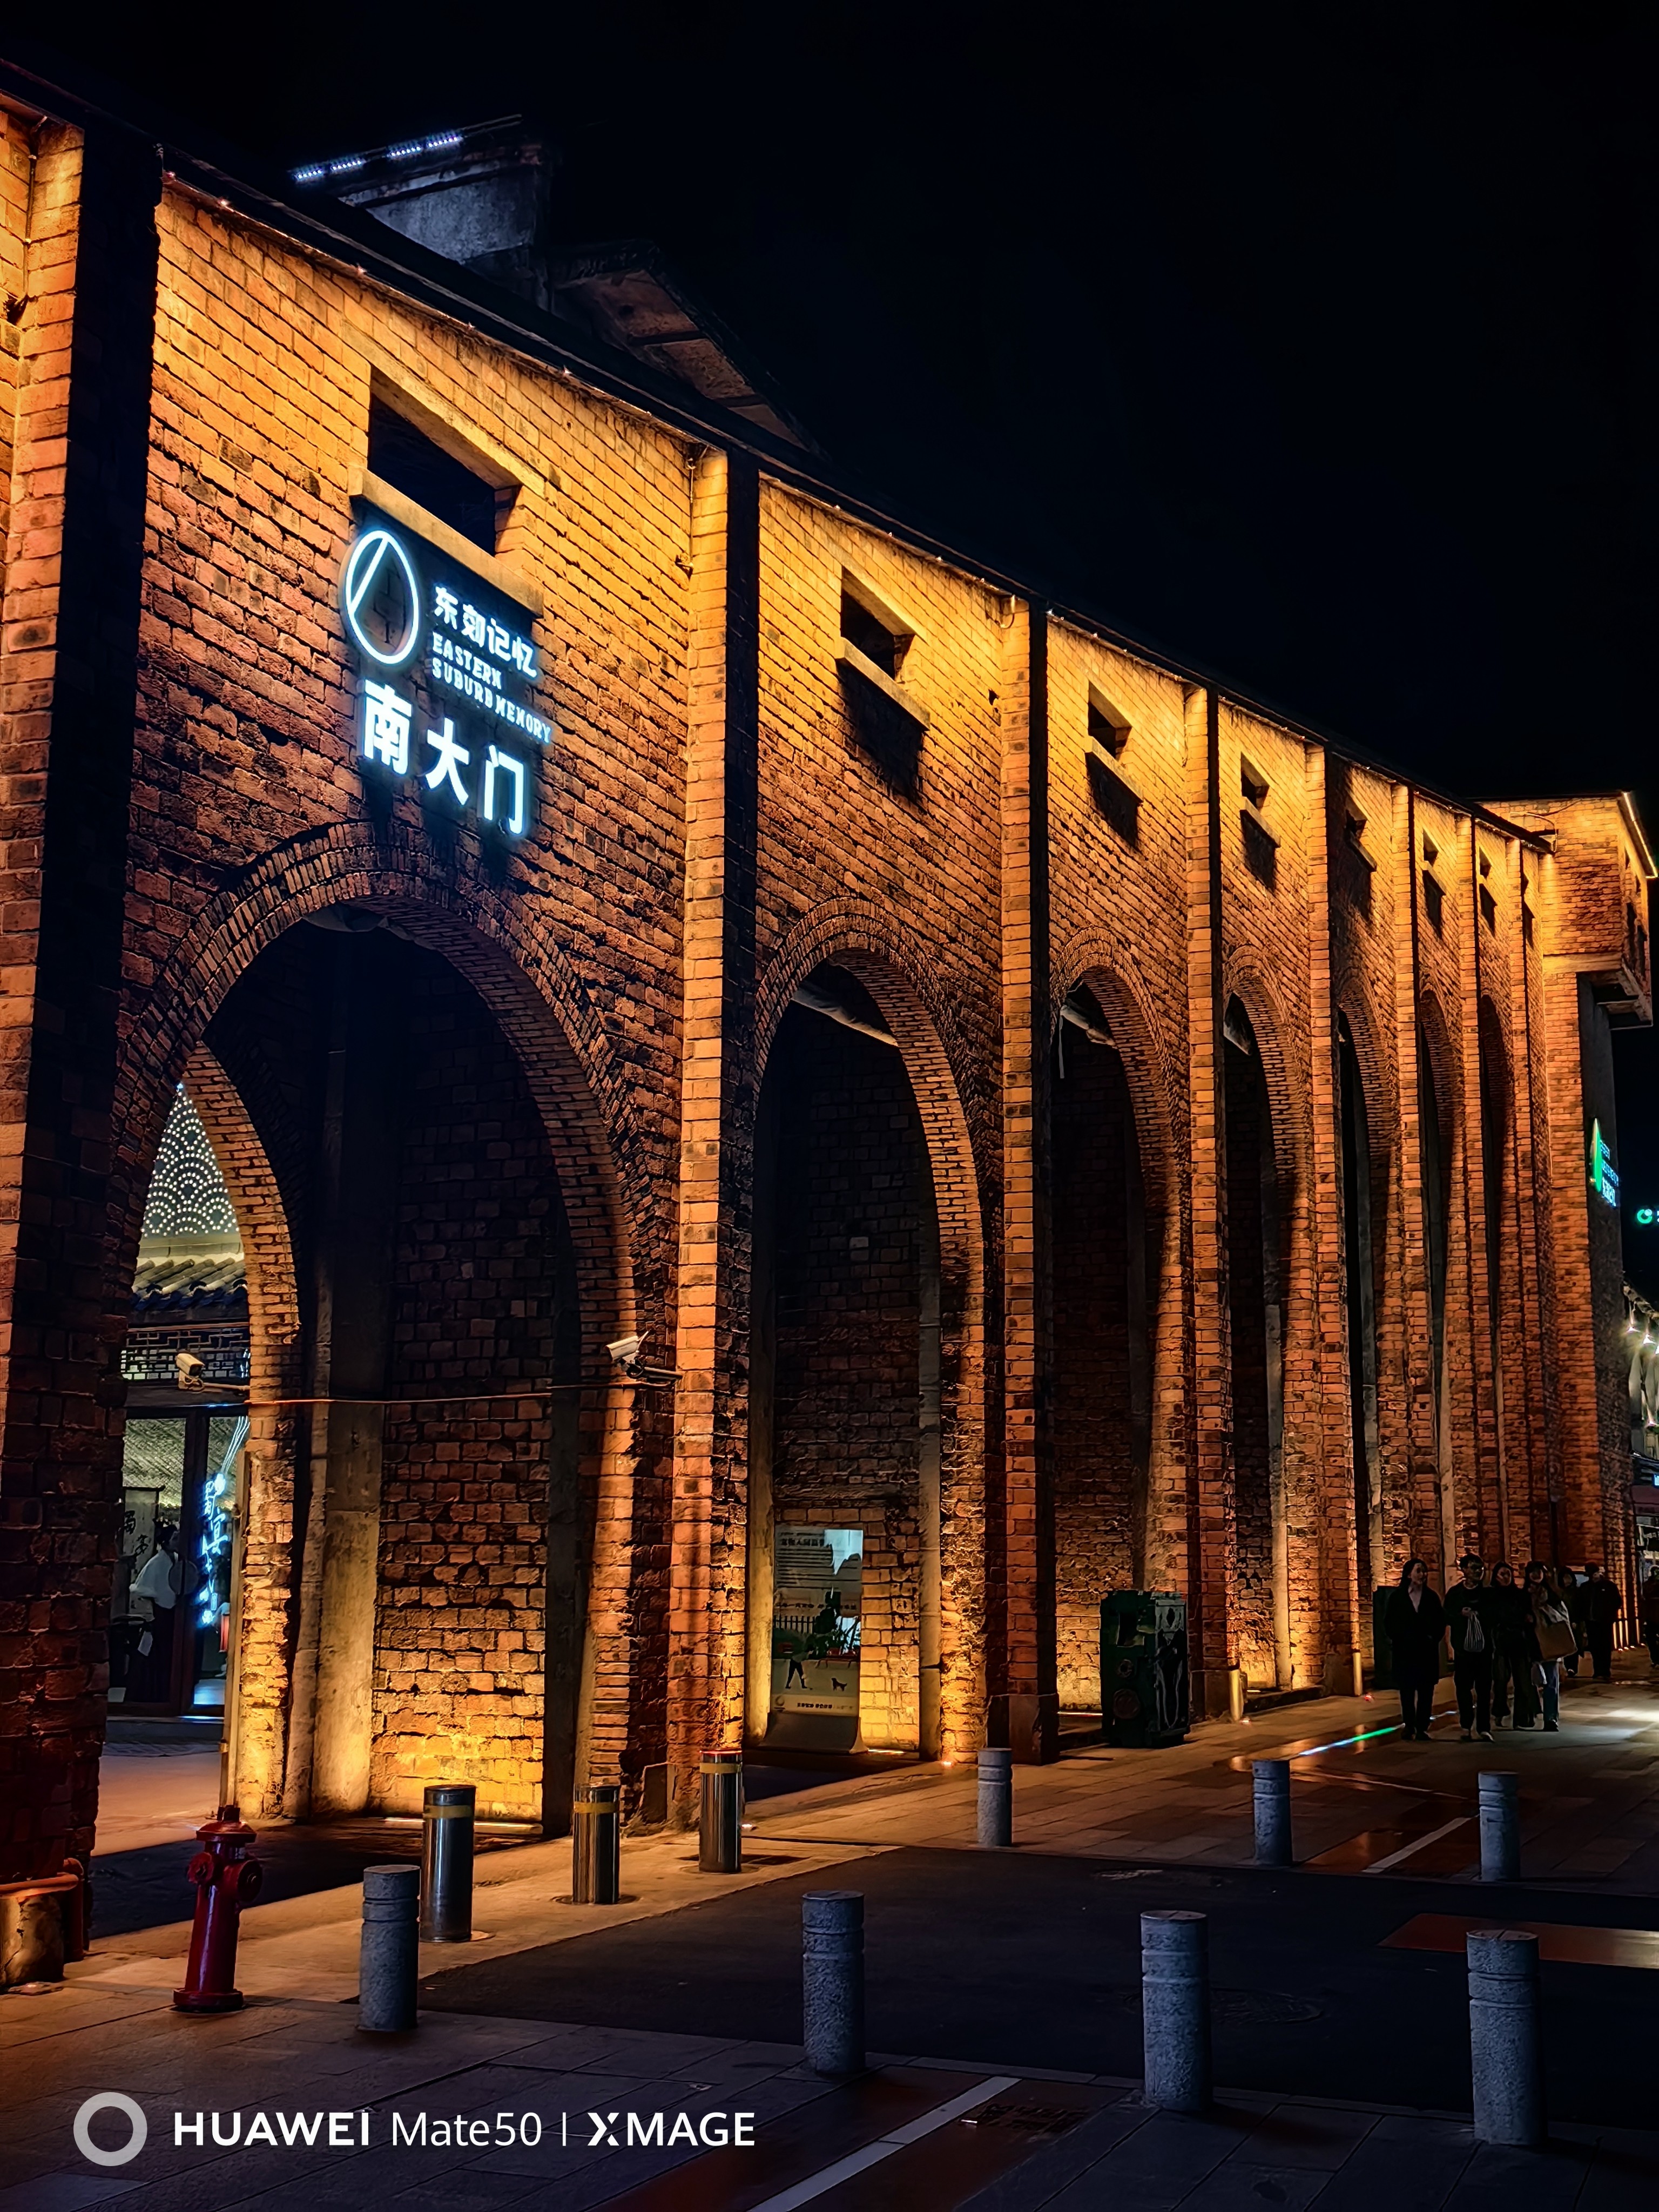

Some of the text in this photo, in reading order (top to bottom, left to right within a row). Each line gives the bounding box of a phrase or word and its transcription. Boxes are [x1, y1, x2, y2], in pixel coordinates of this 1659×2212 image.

[432, 632, 501, 690] EASTERN
[434, 586, 537, 678] 东郊记忆
[432, 657, 551, 743] SUBURB MEMORY
[364, 679, 525, 834] 南大门
